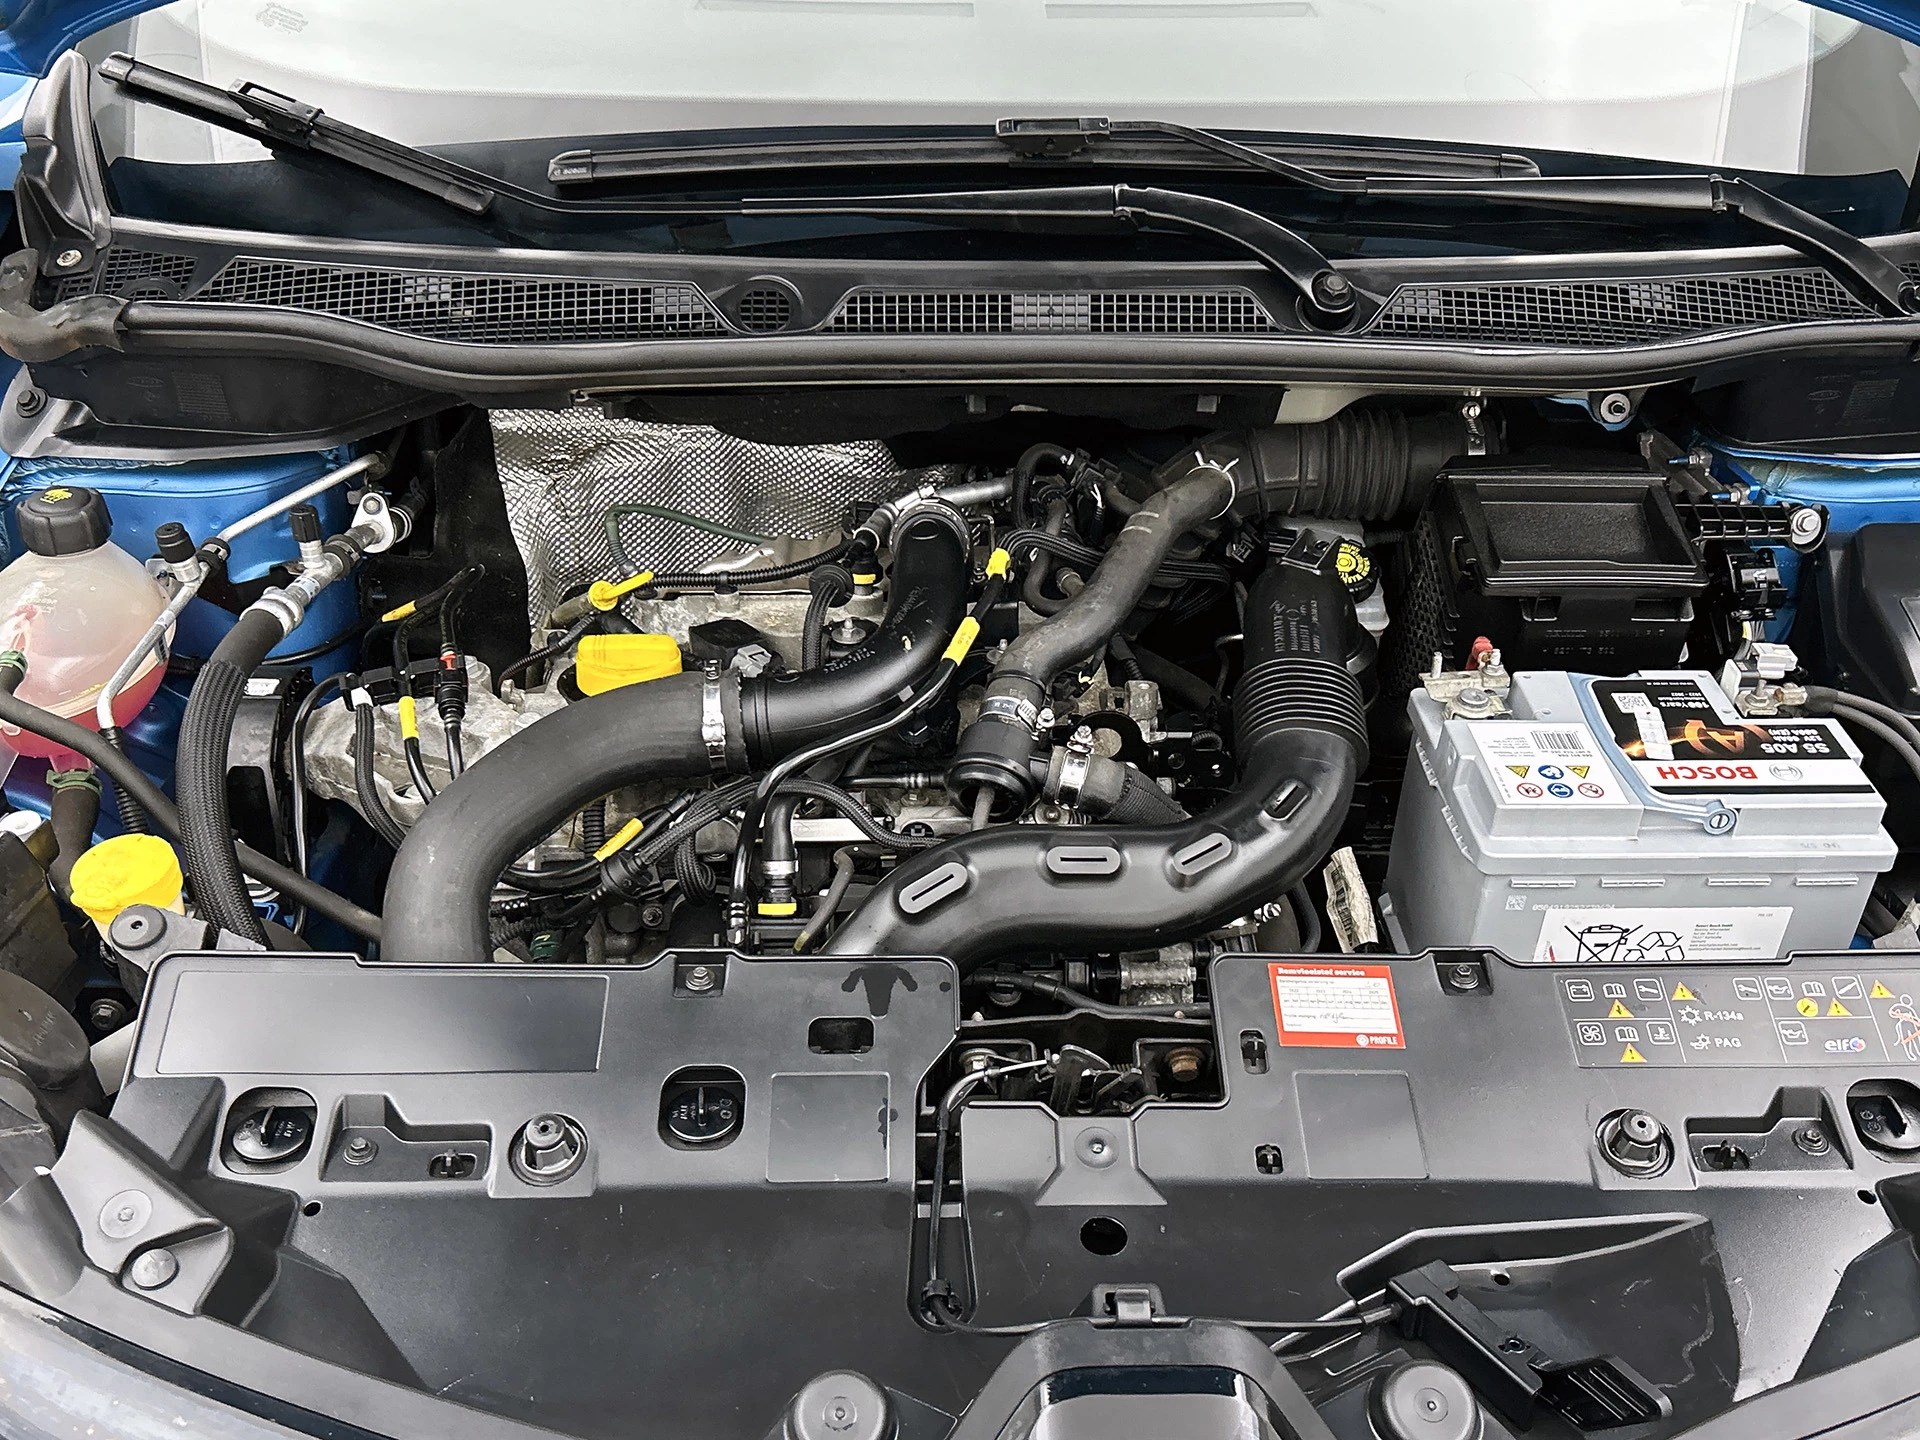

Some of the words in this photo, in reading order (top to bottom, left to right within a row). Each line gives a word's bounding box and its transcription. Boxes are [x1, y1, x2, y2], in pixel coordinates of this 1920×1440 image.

[1760, 743, 1798, 754] A05
[1802, 743, 1830, 754] S5
[1656, 766, 1758, 780] BOSCH
[1703, 1011, 1744, 1021] R-134a
[1369, 1035, 1398, 1045] PROFILE
[1714, 1038, 1742, 1048] PAG
[1824, 1039, 1851, 1051] elf
